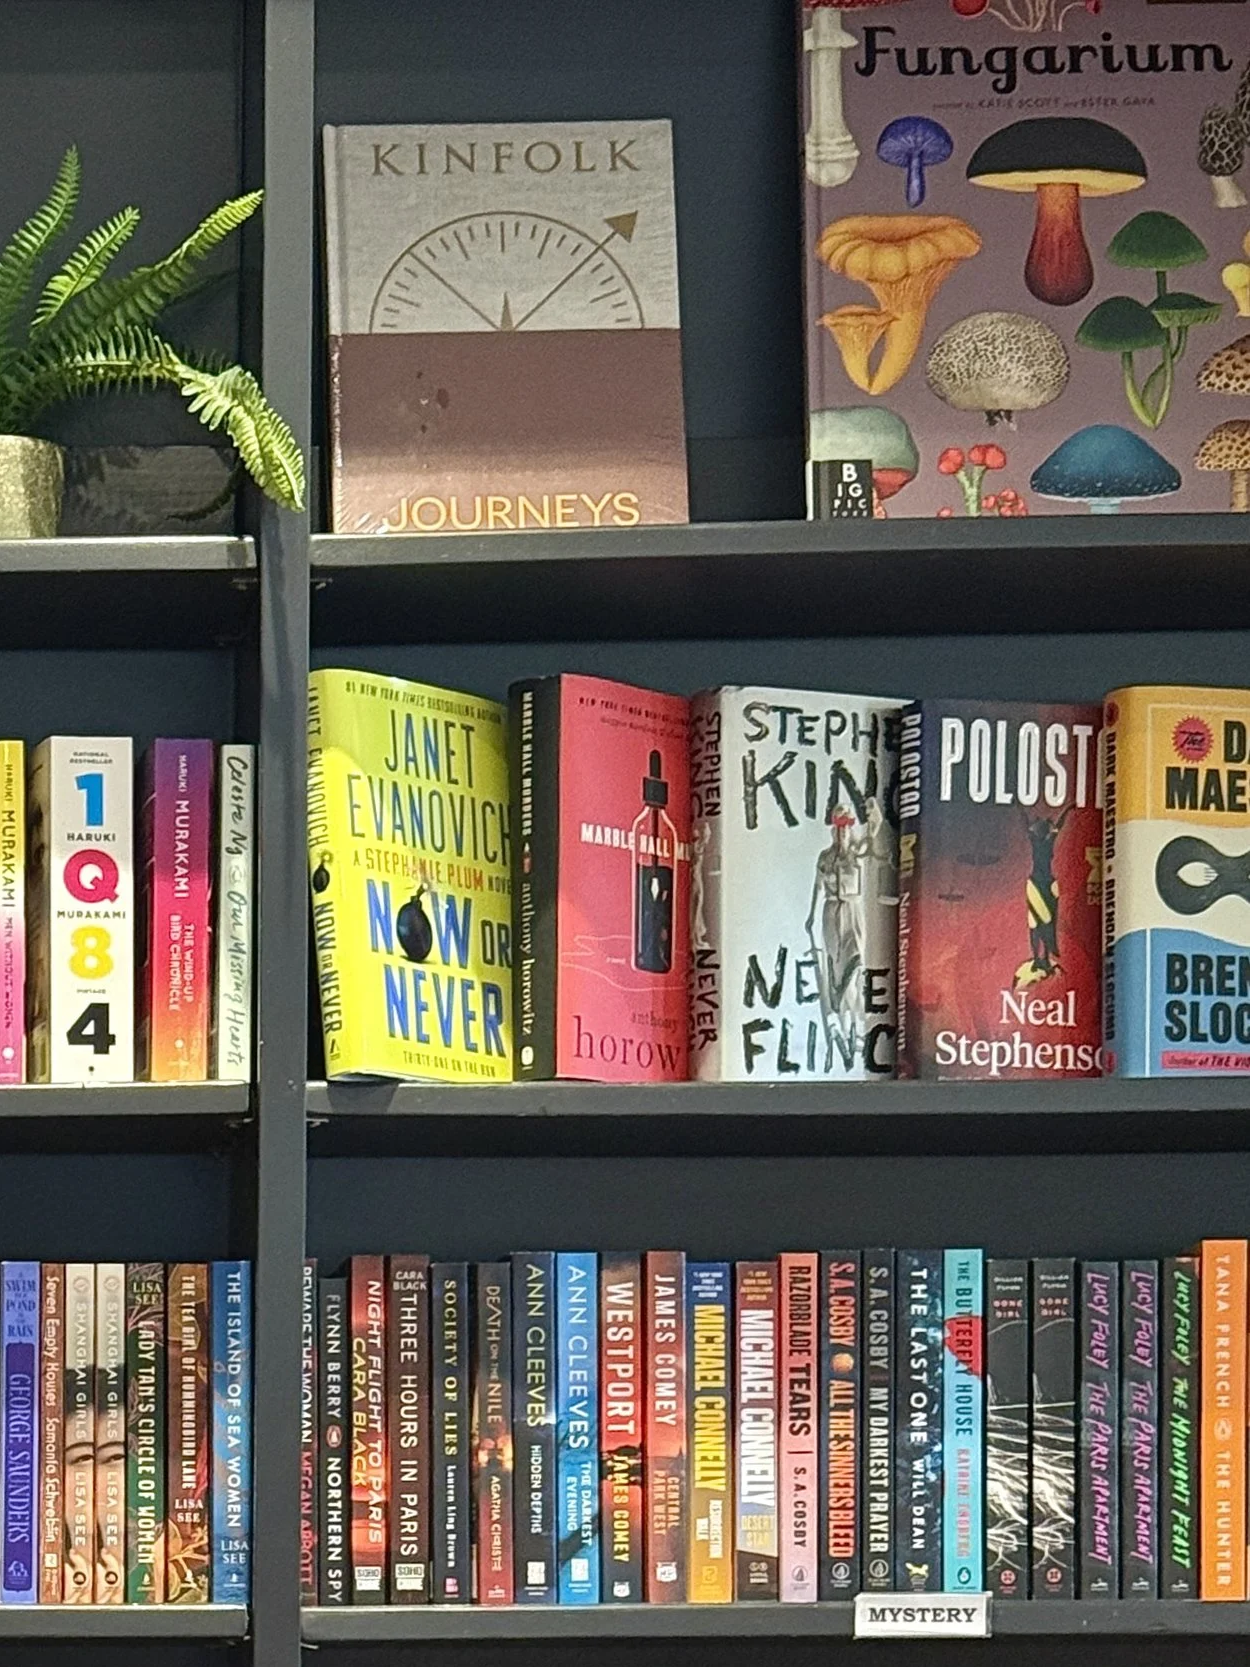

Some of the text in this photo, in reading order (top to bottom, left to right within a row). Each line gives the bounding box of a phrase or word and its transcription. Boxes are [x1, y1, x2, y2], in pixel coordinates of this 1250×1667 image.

[855, 26, 1233, 93] Fungarium
[371, 141, 641, 177] KINFOLK
[384, 492, 640, 529] JOURNEYS
[384, 709, 476, 789] JANET
[521, 692, 533, 836] MARBLE HALL MURDERS
[75, 772, 104, 826] 1
[67, 833, 116, 842] HARUKI
[63, 849, 119, 903] Q
[57, 910, 126, 919] MURAKAMI
[69, 926, 114, 979] 8
[519, 883, 534, 1036] anthony horowitz
[66, 1002, 116, 1054] 4
[384, 964, 506, 1057] NEVER
[1001, 990, 1076, 1027] Neal
[228, 1272, 241, 1527] THE ISLAND OF SEA WOMEN
[401, 1295, 418, 1556] THREE HOURS IN PARIS
[607, 1282, 634, 1562] WESTPORT JAMES COMEY
[1216, 1255, 1230, 1585] TANA FRENCH THE HUNTER
[868, 1608, 977, 1622] MYSTERY
